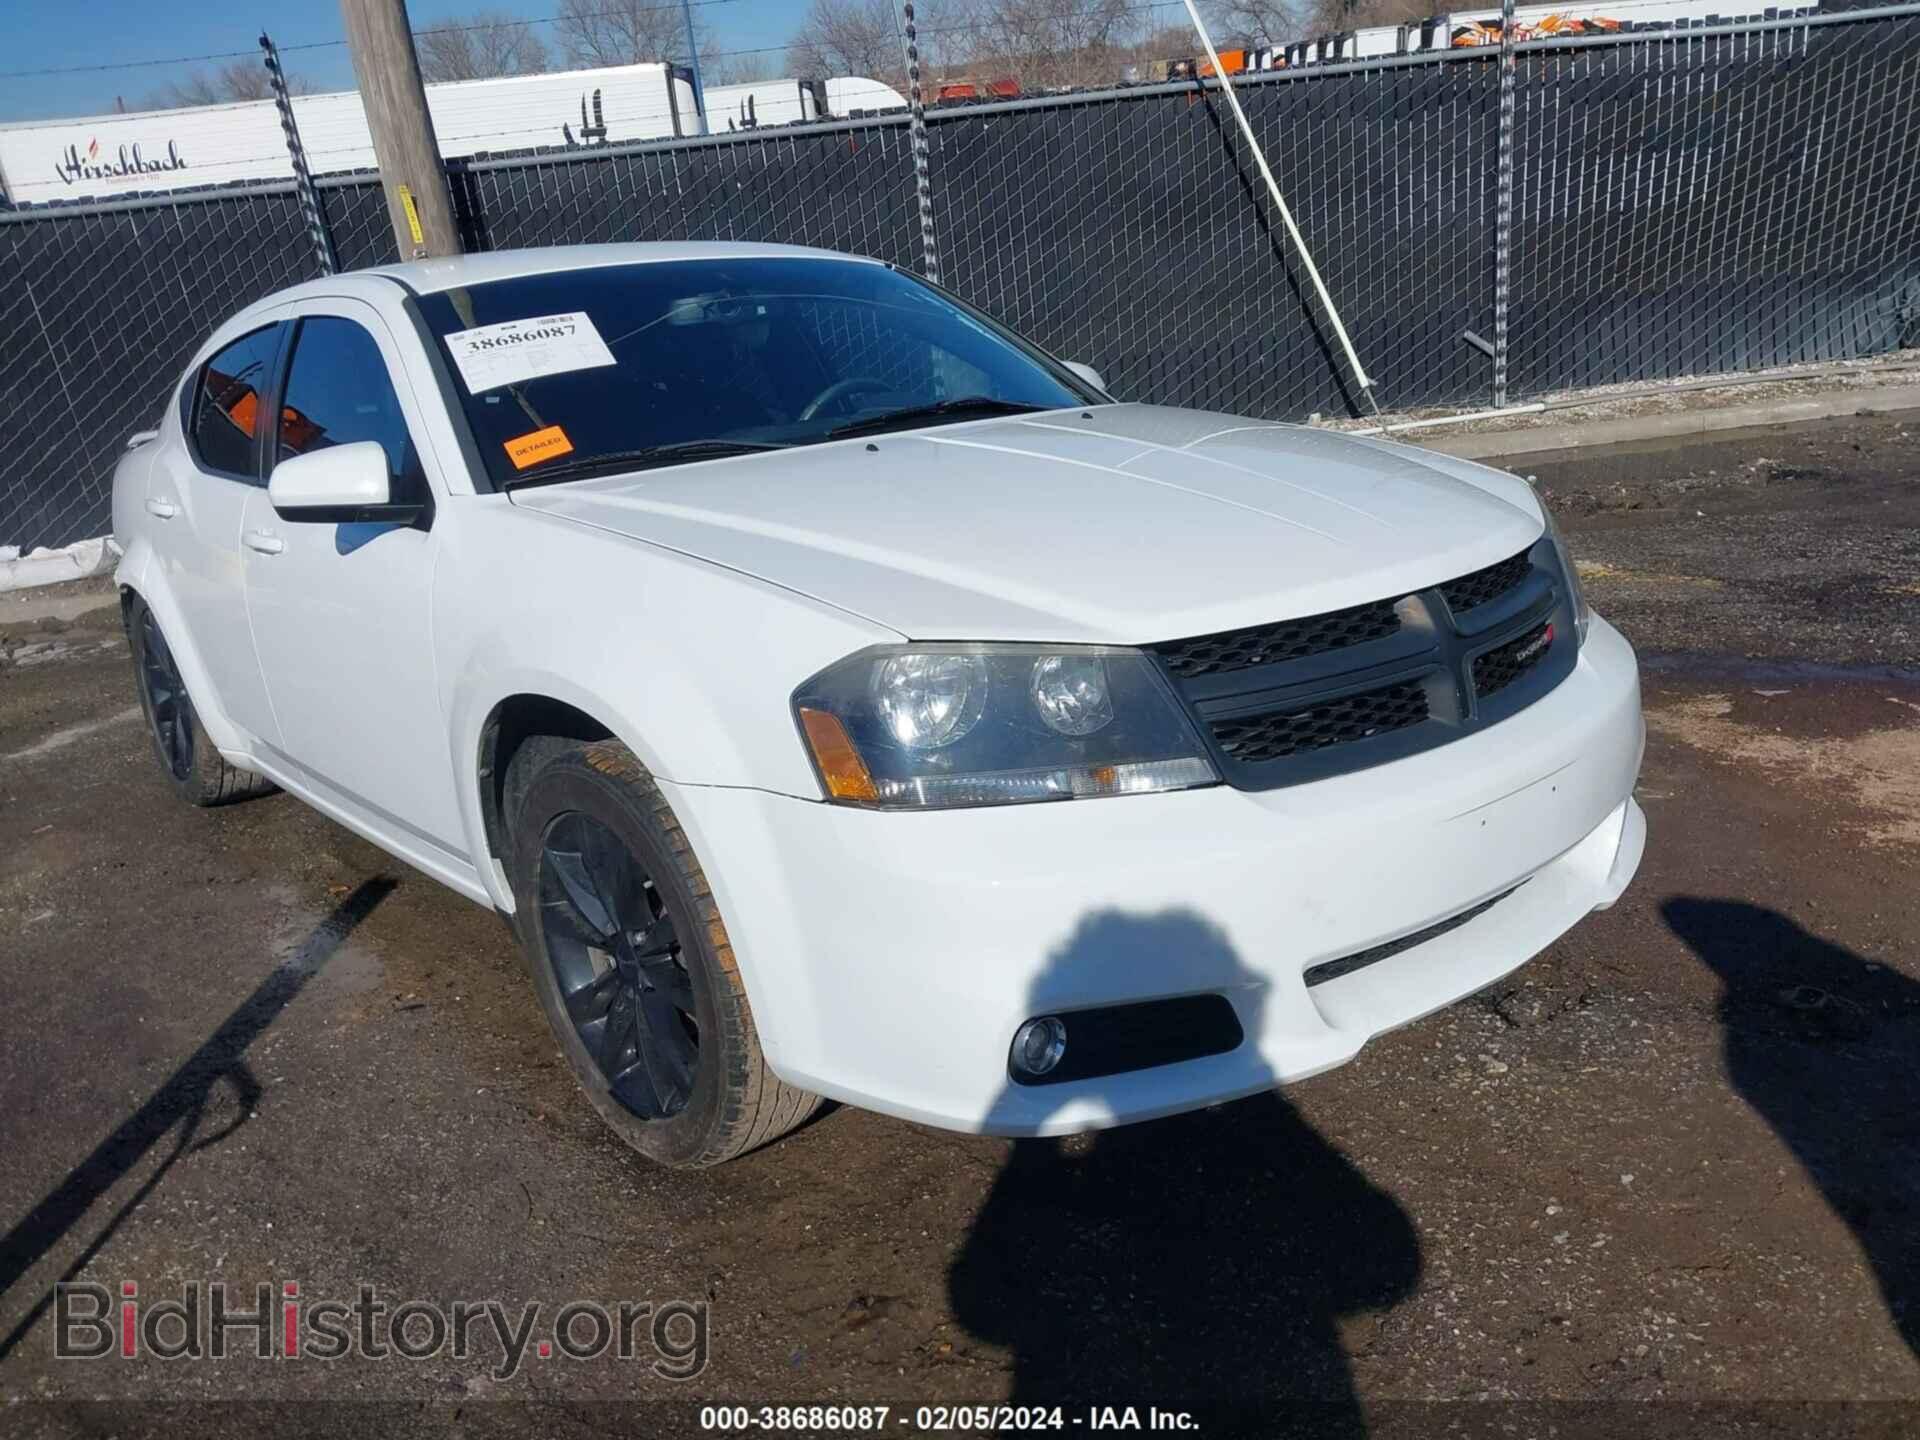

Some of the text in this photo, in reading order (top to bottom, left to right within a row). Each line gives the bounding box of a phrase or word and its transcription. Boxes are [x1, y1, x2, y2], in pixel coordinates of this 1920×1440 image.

[55, 138, 187, 185] Hirschbach
[466, 324, 576, 354] 38686087
[515, 436, 561, 457] DETAILED
